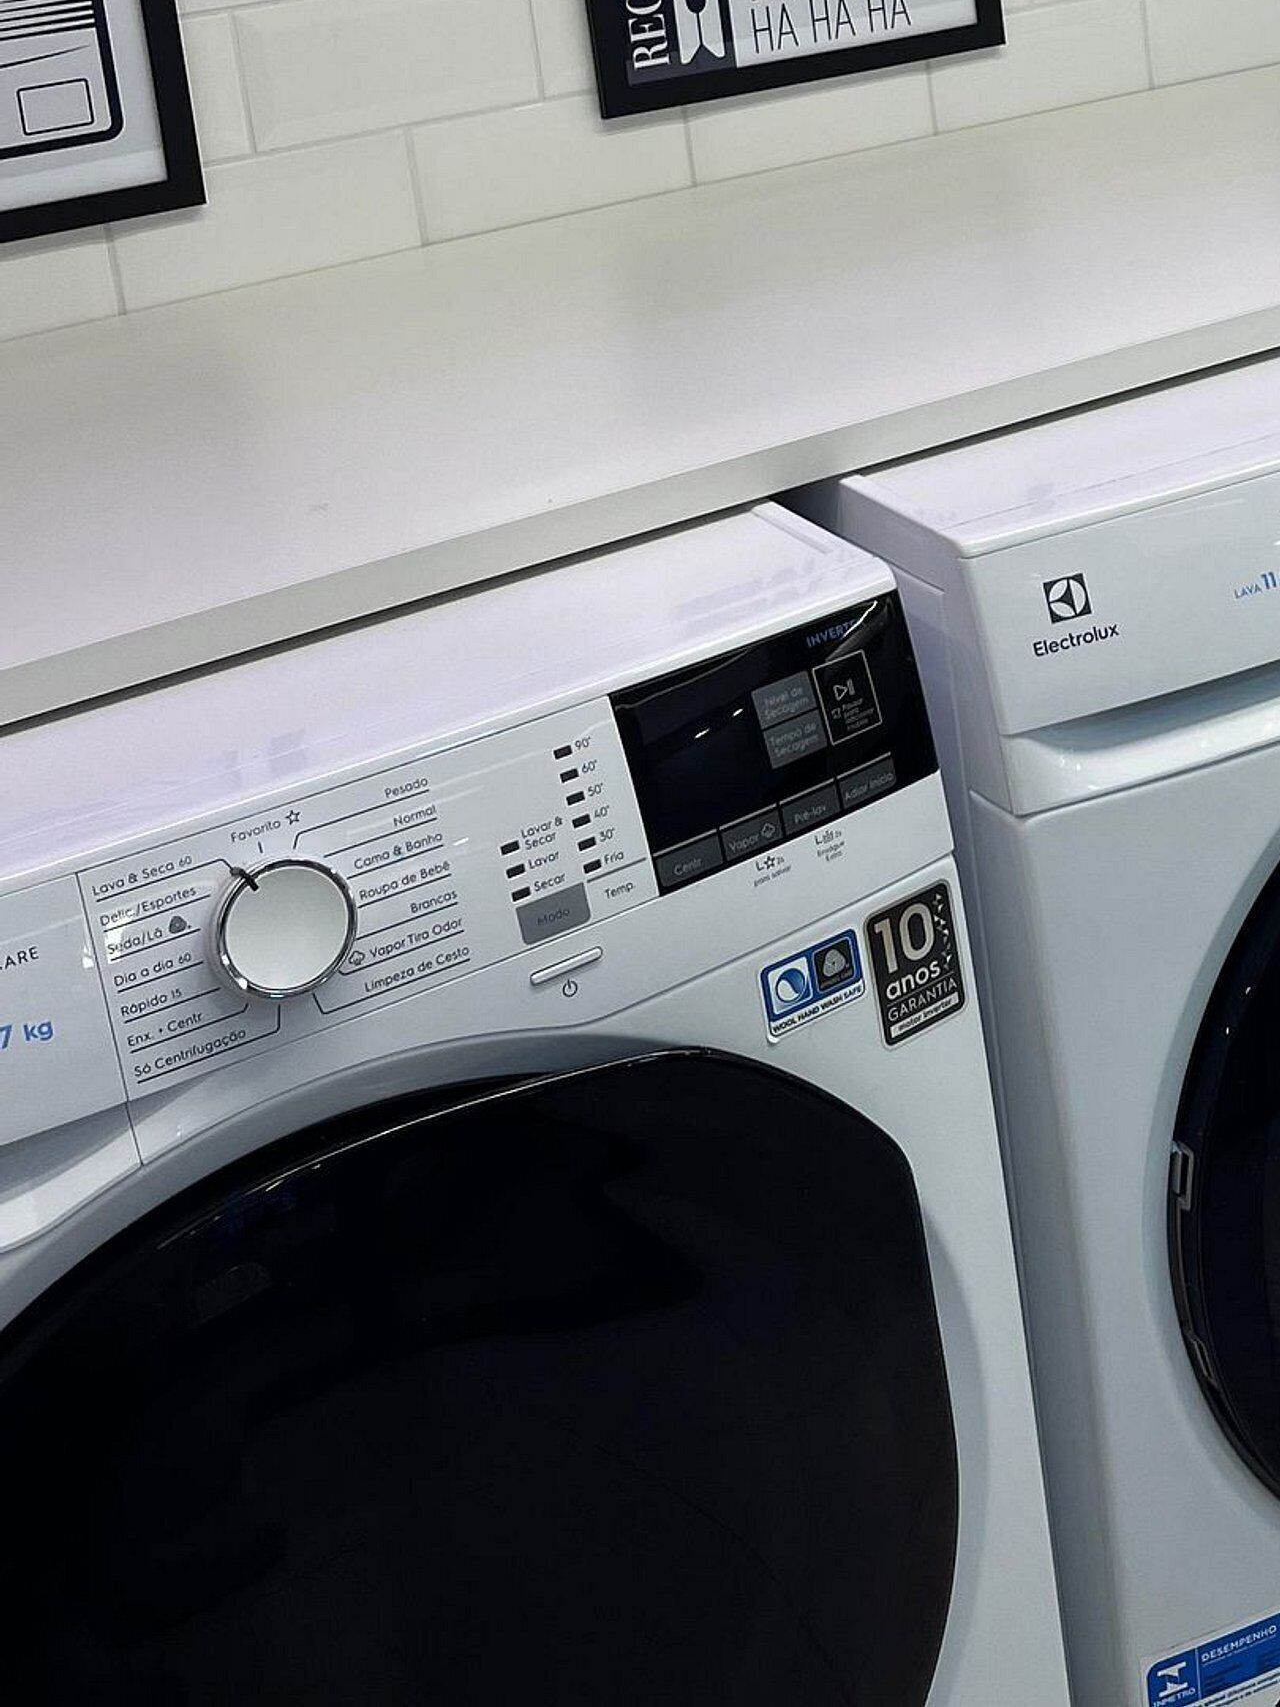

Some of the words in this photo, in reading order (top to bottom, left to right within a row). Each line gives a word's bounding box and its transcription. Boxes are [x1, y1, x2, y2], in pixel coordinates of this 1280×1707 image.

[751, 5, 799, 53] HA
[1234, 584, 1262, 599] LAVA
[1261, 571, 1277, 589] 11
[1032, 621, 1120, 658] Electrolux
[581, 760, 597, 773] 60°
[384, 777, 428, 798] Pesado
[588, 783, 604, 797] 50°
[393, 804, 437, 827] Normal
[521, 821, 552, 839] Lavar
[554, 816, 563, 826] &
[230, 817, 282, 844] Favorito
[525, 831, 556, 850] Secar
[354, 850, 390, 870] Cama
[392, 844, 403, 856] &
[406, 832, 443, 852] Banho
[528, 851, 559, 869] Lavar
[92, 878, 125, 896] Lava
[127, 873, 138, 885] &
[142, 860, 175, 880] Seca
[178, 856, 192, 869] 60
[359, 880, 398, 901] Roupa
[402, 872, 417, 885] de
[420, 861, 450, 880] Bebê
[534, 873, 566, 892] Secar
[410, 889, 458, 913] Brancas
[369, 937, 405, 959] Vapor
[431, 917, 463, 935] Odor
[874, 902, 935, 974] 10
[0, 946, 39, 970] ARE
[114, 973, 137, 987] Dia
[140, 967, 150, 978] a
[153, 958, 174, 973] dia
[178, 952, 192, 965] 60
[364, 967, 415, 992] Limpeza
[417, 958, 433, 972] de
[436, 946, 470, 964] Cesto
[886, 959, 940, 1000] anos
[121, 993, 168, 1017] Rápido
[170, 989, 182, 999] 15
[888, 977, 958, 1021] GARANTIA
[24, 1021, 54, 1041] kg
[773, 1016, 797, 1033] WOOL
[134, 1063, 151, 1077] Só
[155, 1029, 247, 1070] Centrifugação
[1202, 1625, 1277, 1662] DESEMPENHO
